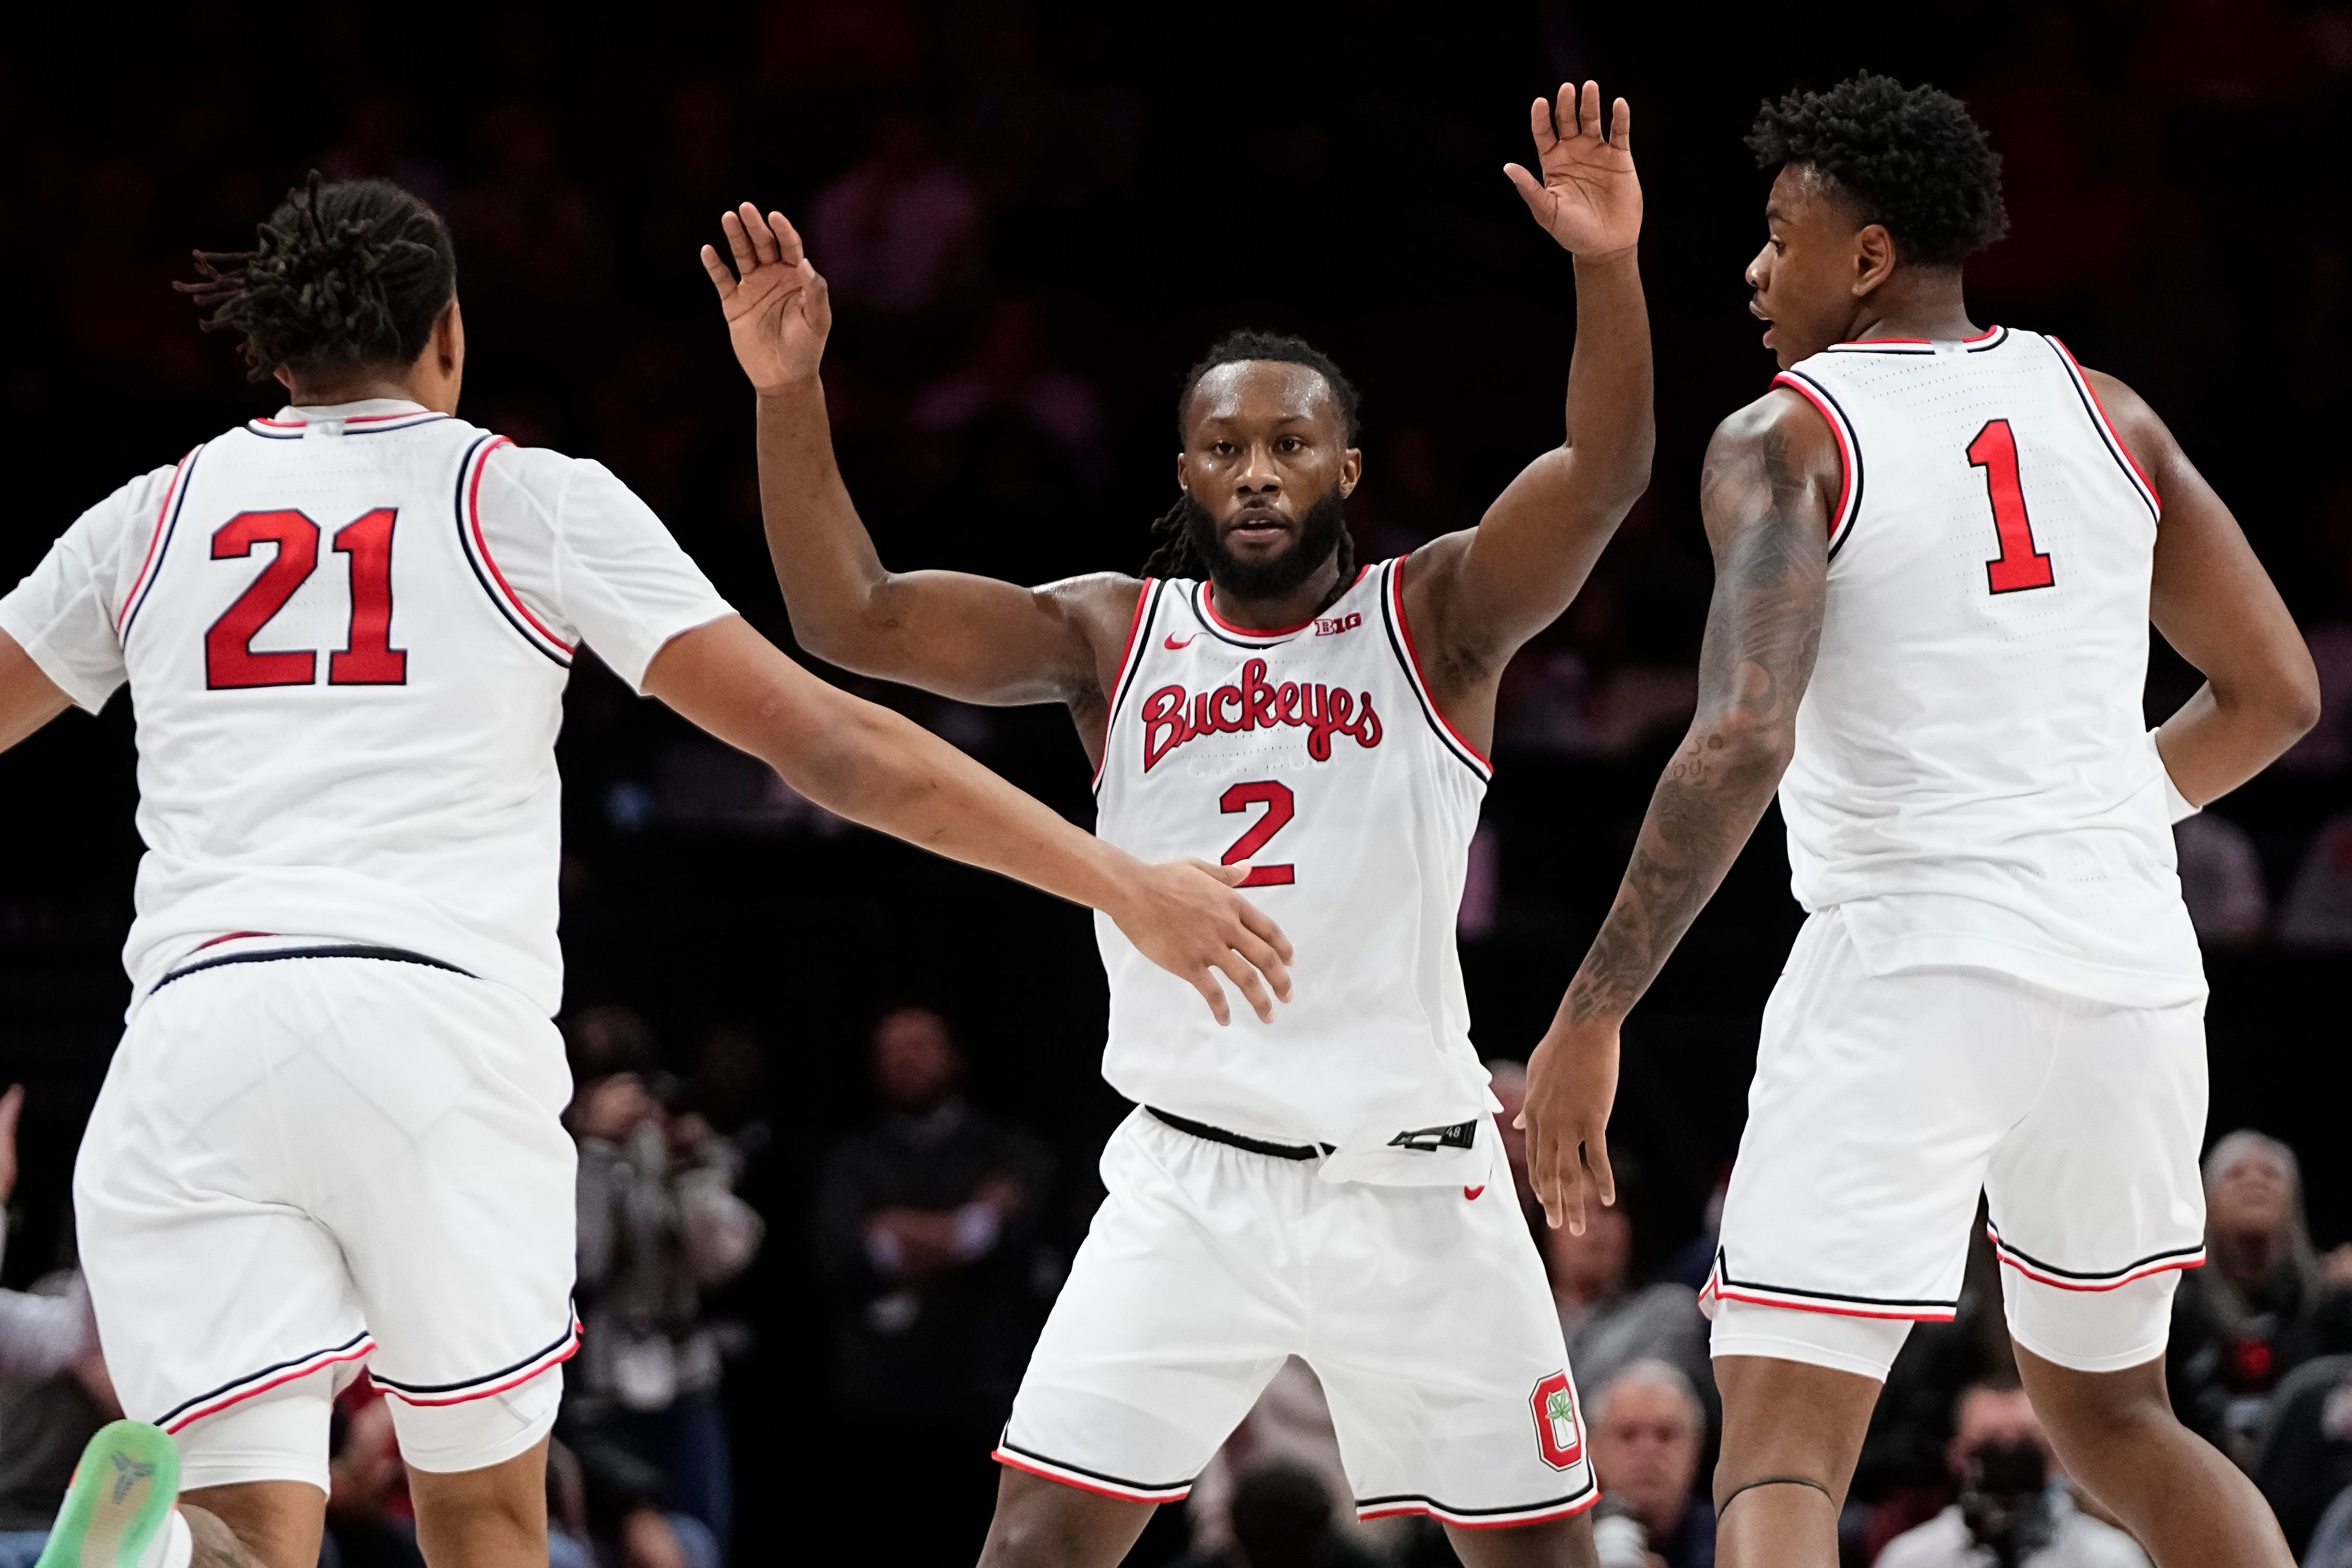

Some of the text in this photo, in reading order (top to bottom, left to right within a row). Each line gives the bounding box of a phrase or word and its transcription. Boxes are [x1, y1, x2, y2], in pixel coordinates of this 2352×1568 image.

[1965, 418, 2055, 595] 1
[204, 506, 408, 690] 21
[1142, 658, 1382, 774] Buckeyes
[1219, 780, 1295, 889] 2
